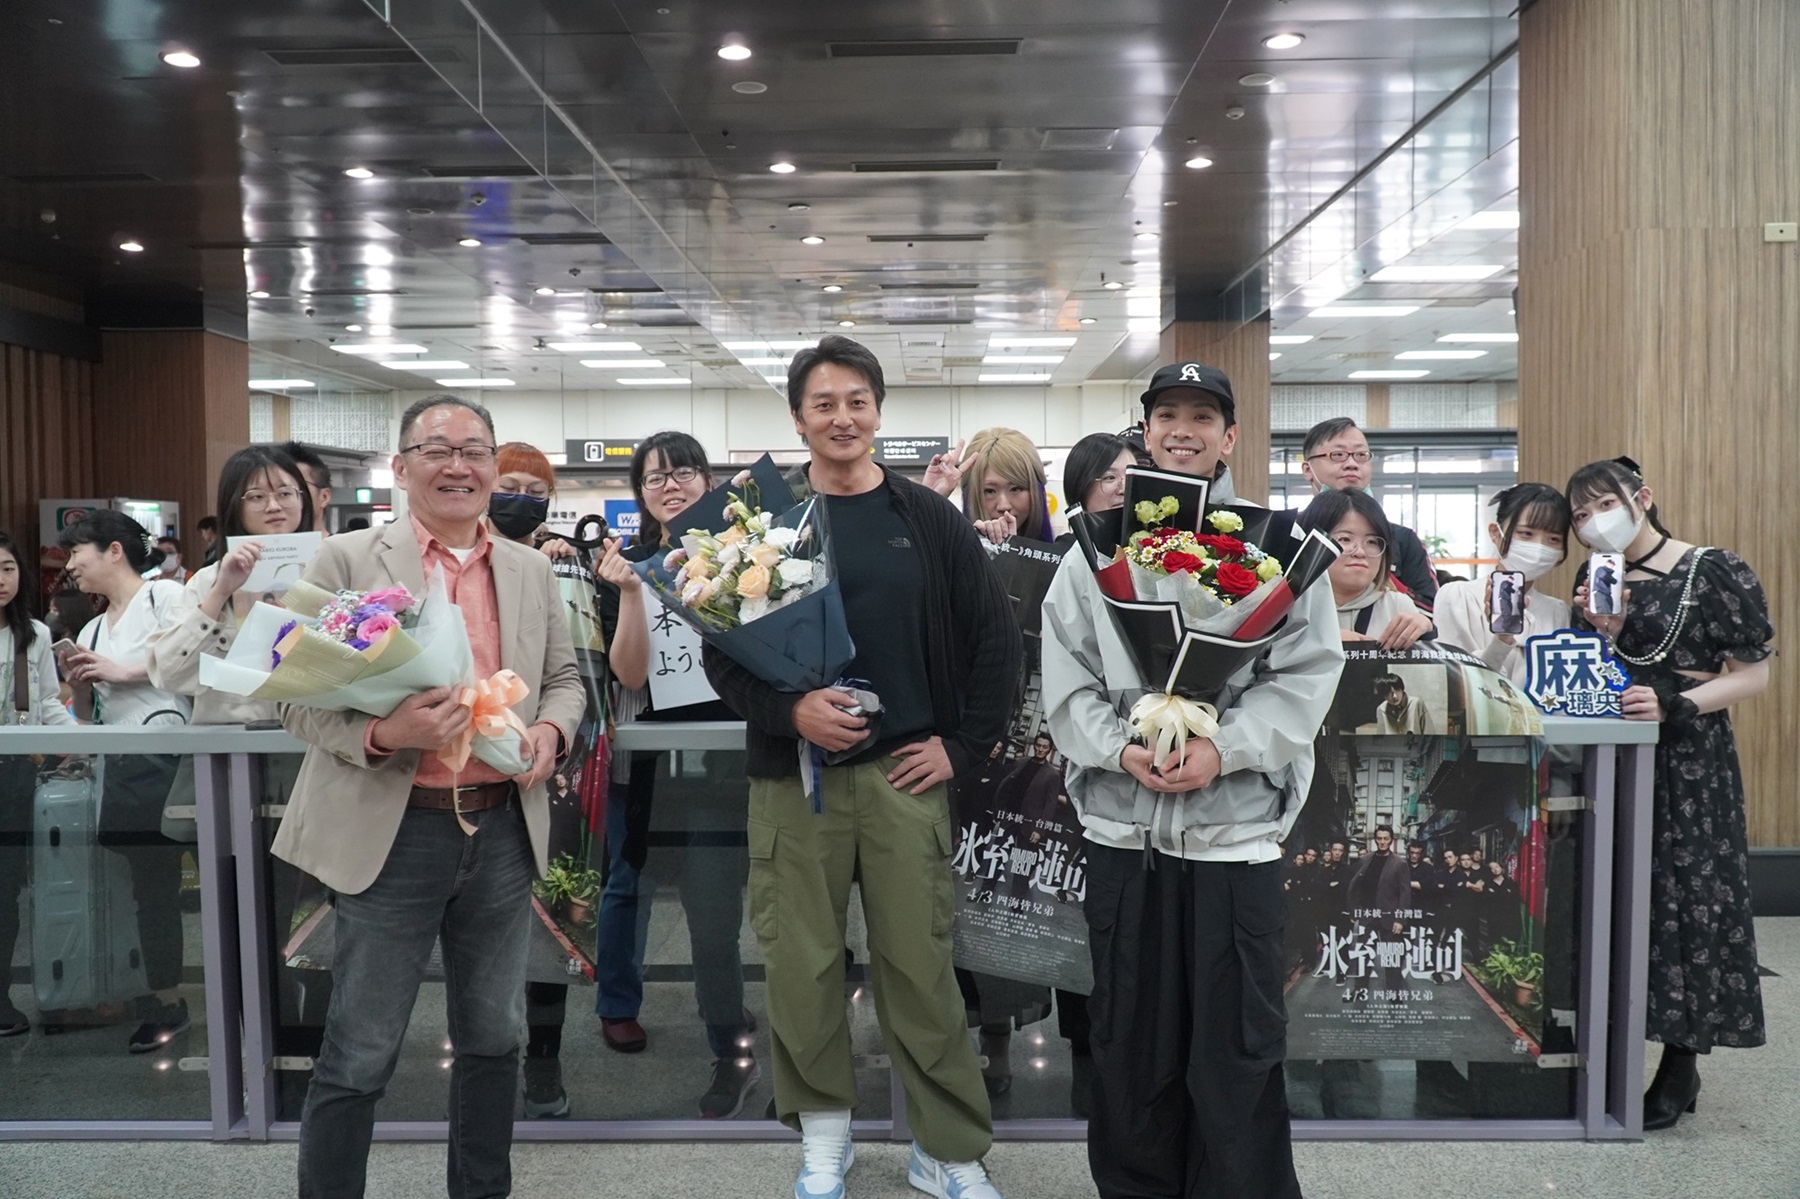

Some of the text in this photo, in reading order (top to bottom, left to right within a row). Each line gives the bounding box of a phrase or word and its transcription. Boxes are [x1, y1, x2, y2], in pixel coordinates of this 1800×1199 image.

[656, 646, 703, 676] よう
[1535, 639, 1601, 698] 麻
[1568, 690, 1620, 714] 璃央
[997, 810, 1033, 824] 日本統一
[1010, 847, 1038, 866] HIMURO
[1010, 860, 1032, 876] RENJI
[967, 887, 1055, 917] 4/3 四海皆兄弟
[1354, 908, 1423, 919] 日本統一 台灣篇
[1376, 941, 1405, 956] HIMURO
[1380, 953, 1401, 968] RENJI
[1341, 988, 1433, 1002] 4/3 四海皆兄弟
